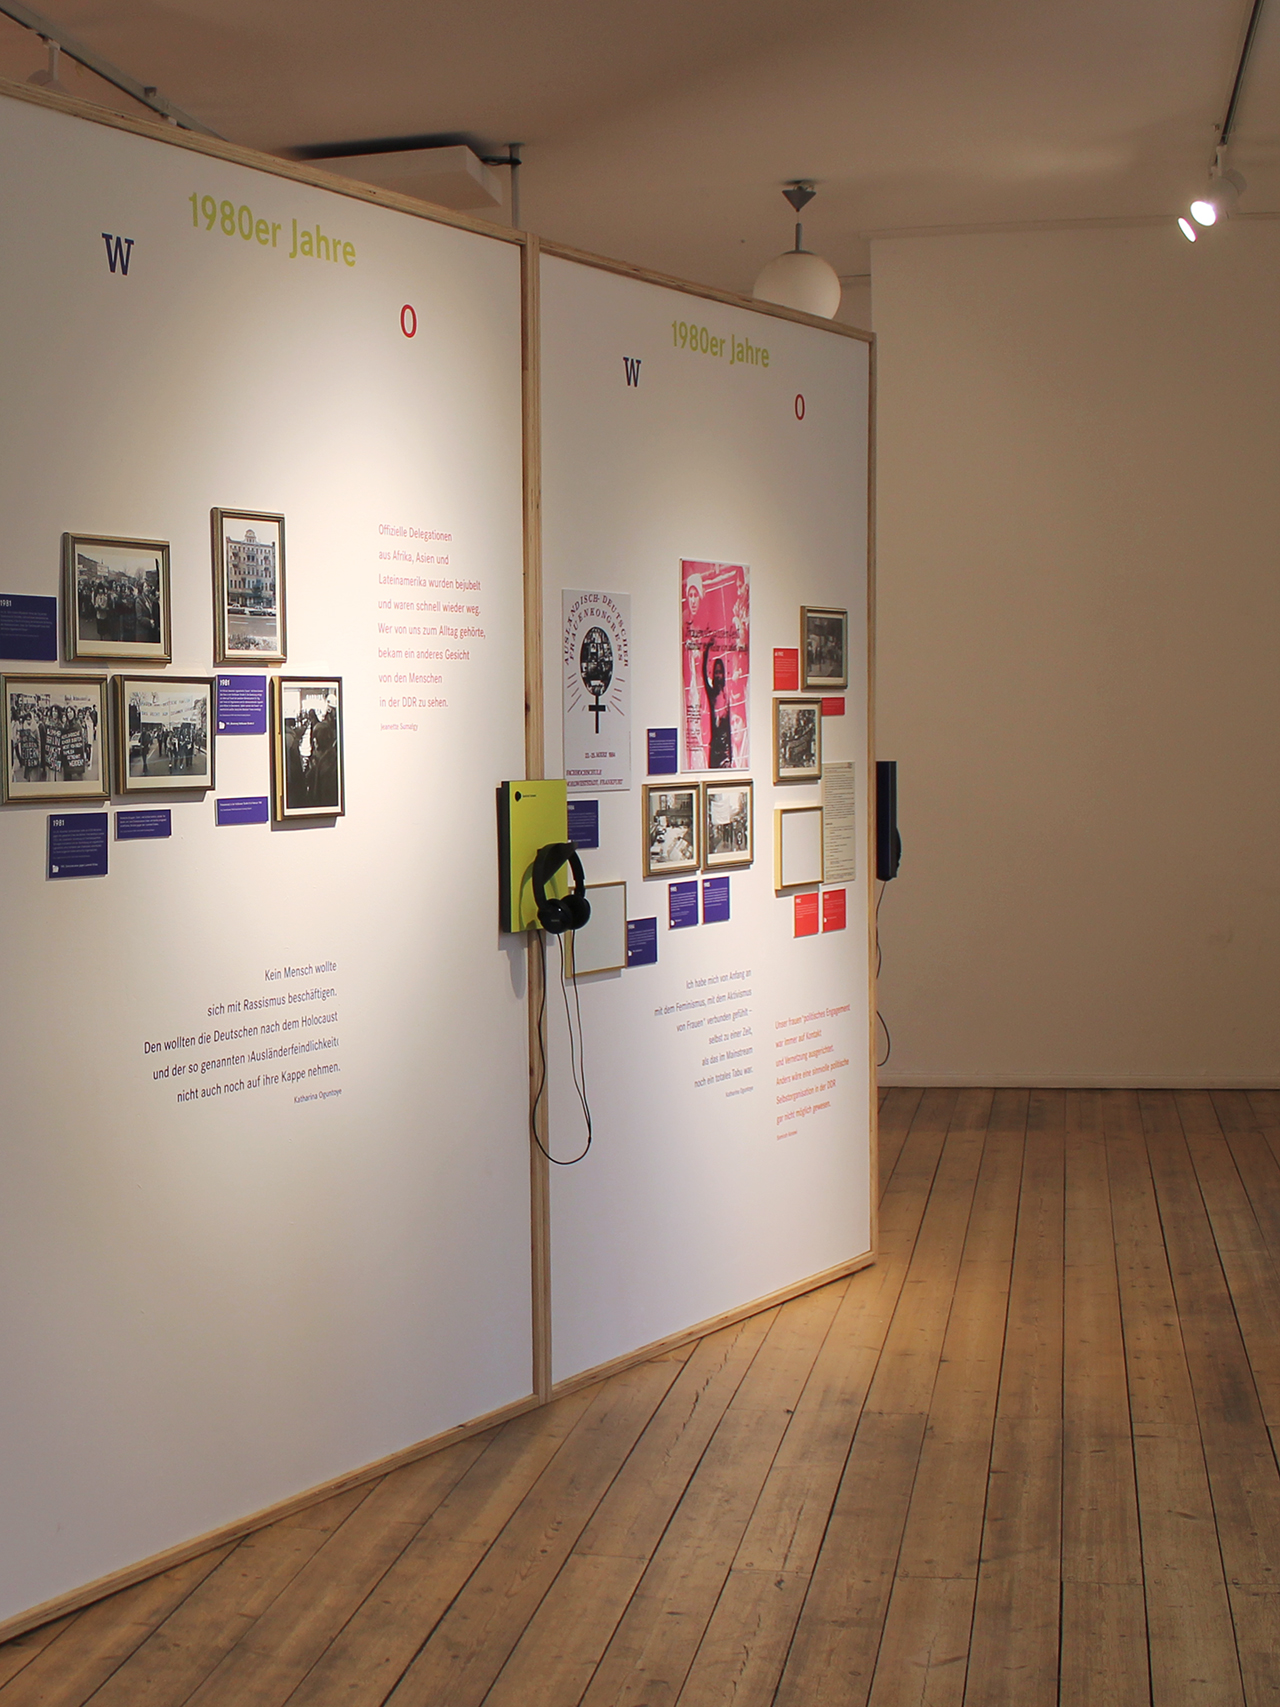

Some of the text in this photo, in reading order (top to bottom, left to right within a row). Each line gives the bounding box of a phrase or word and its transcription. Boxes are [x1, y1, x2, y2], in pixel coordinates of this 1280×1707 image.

[189, 193, 356, 267] 1980er Jahre
[102, 233, 134, 275] W
[401, 305, 417, 338] O
[672, 321, 769, 368] 1980er Jahre
[623, 357, 641, 387] W
[795, 394, 805, 420] O
[379, 524, 453, 542] Offizielle Delegationen
[379, 550, 450, 565] aus Afrika, Asien und
[379, 574, 480, 592] Lateinamerika wurden bejubelt
[0, 599, 12, 607] 1981
[378, 599, 480, 616] und waren schnell wieder weg.
[378, 623, 485, 639] Wer von uns zum Alltag gehörte,
[379, 648, 470, 660] bekam ein anderes Gesicht
[379, 673, 442, 683] von den Menschen
[380, 697, 448, 708] in der DDR zu sehen.
[53, 819, 65, 827] 1981
[265, 961, 336, 981] Kein Mensch wollte
[208, 988, 337, 1016] sich mit Rassismus beschäftigen.
[145, 1012, 338, 1054] Den wollten die Deutschen nach dem Holocaust
[153, 1066, 170, 1080] und
[172, 1064, 186, 1076] der
[188, 1061, 199, 1074] so
[201, 1055, 245, 1074] genannten
[178, 1064, 340, 1102] nicht auch noch auf ihre Kappe nehmen.
